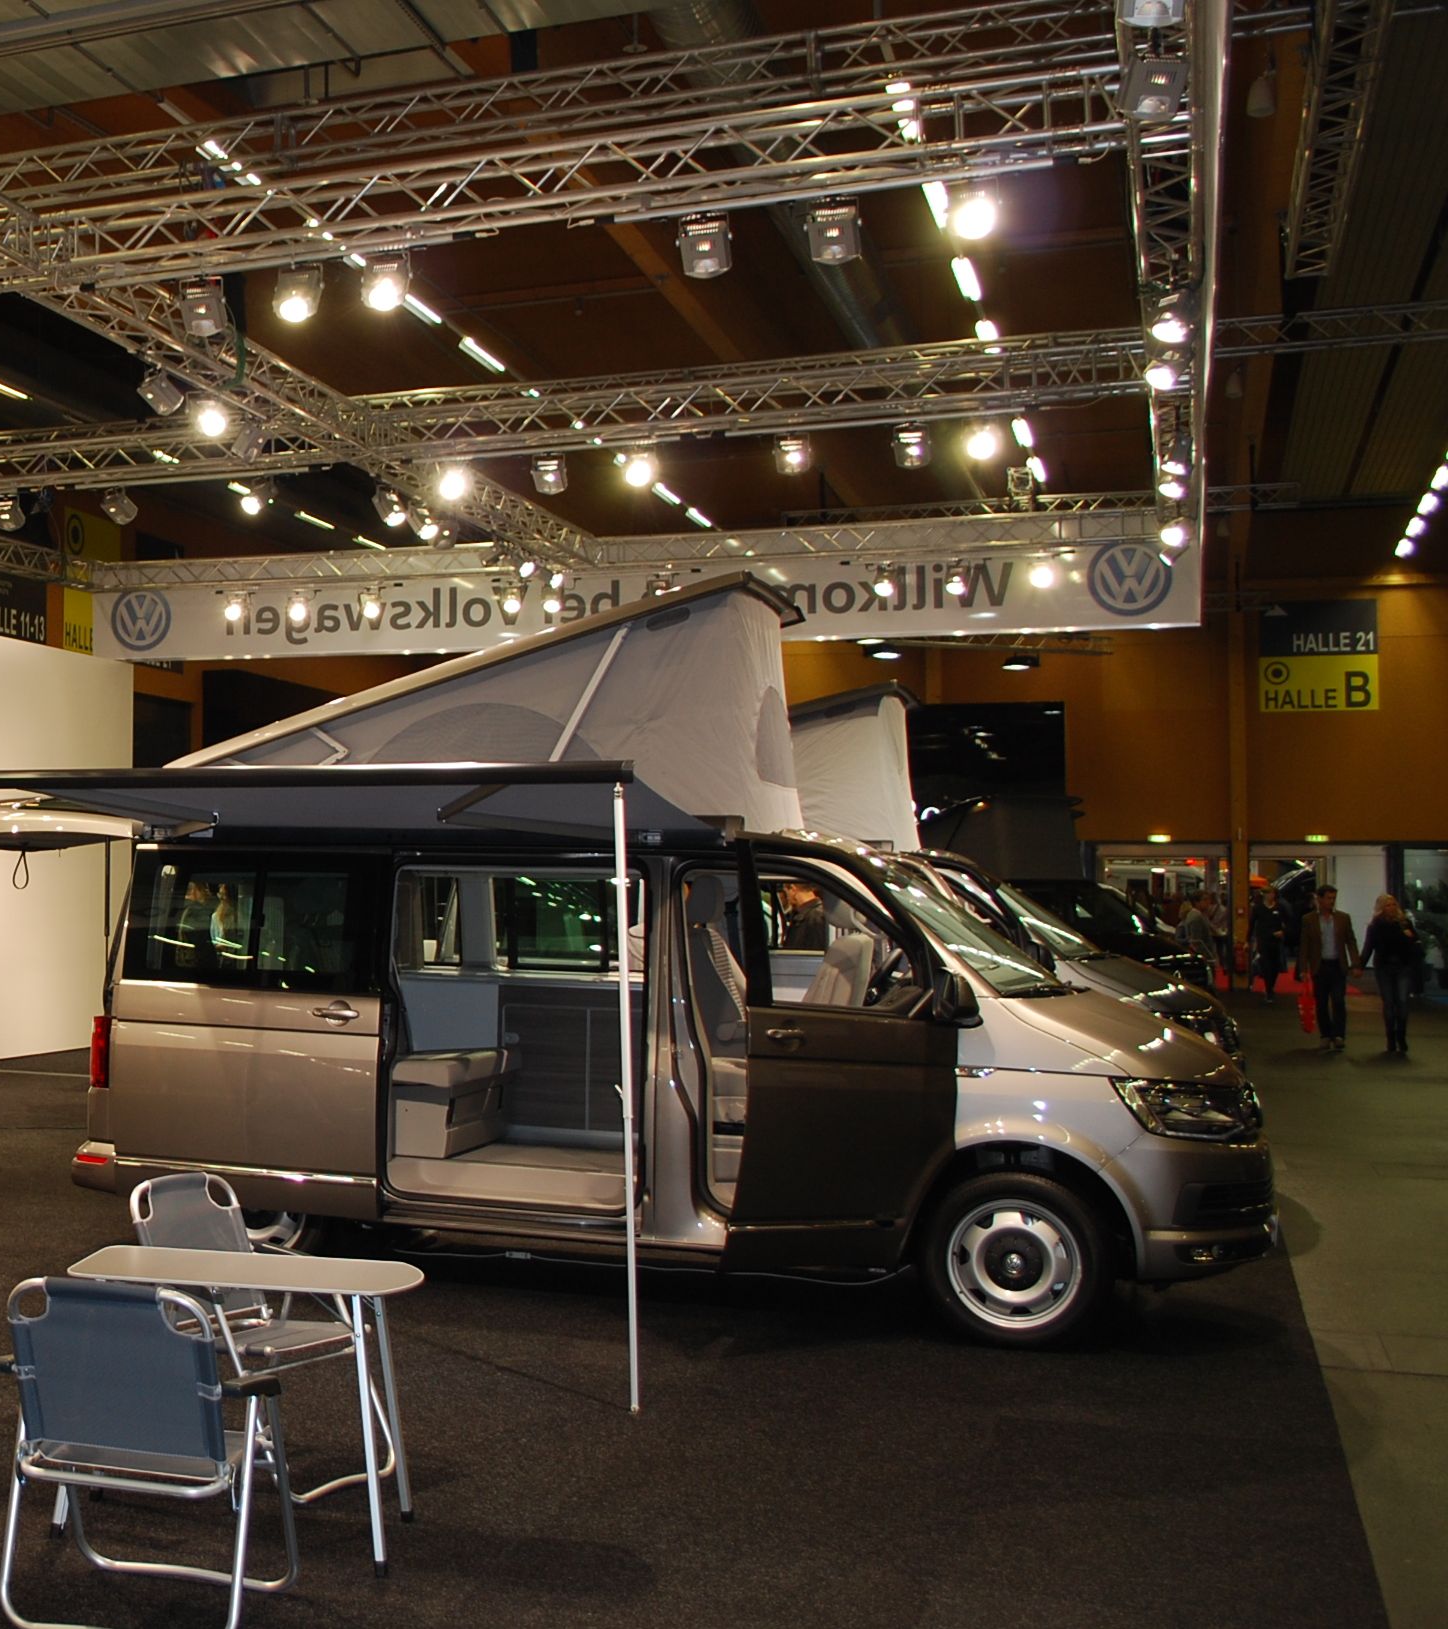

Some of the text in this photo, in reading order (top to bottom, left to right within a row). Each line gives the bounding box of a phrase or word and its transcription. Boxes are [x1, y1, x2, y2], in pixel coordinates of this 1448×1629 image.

[20, 611, 45, 642] 11-13
[1293, 631, 1374, 652] HALLE 21
[1264, 670, 1371, 709] HALLE B
